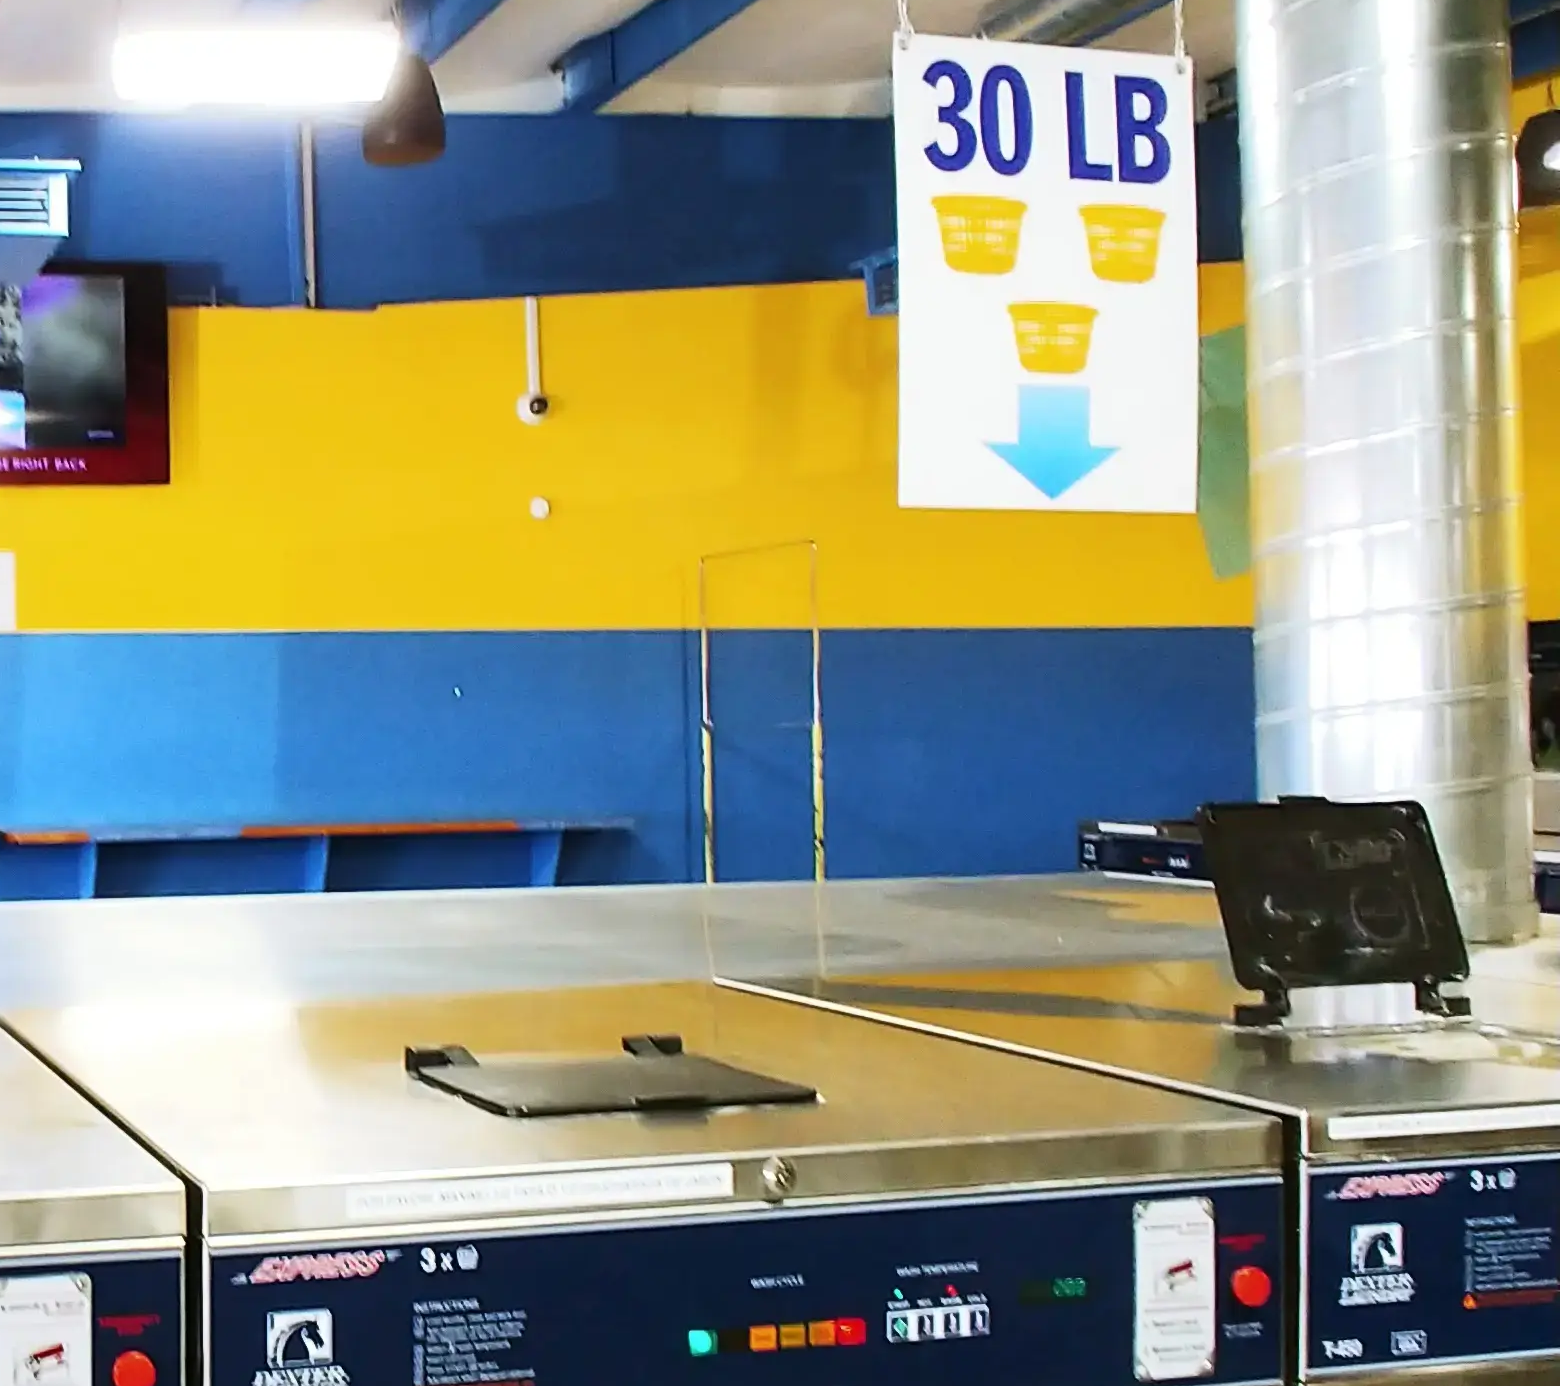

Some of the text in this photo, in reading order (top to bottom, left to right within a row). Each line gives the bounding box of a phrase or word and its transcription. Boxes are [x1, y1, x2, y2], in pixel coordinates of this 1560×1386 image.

[922, 60, 1171, 184] 30 LB
[1469, 1169, 1485, 1192] 3
[419, 1246, 437, 1273] 3
